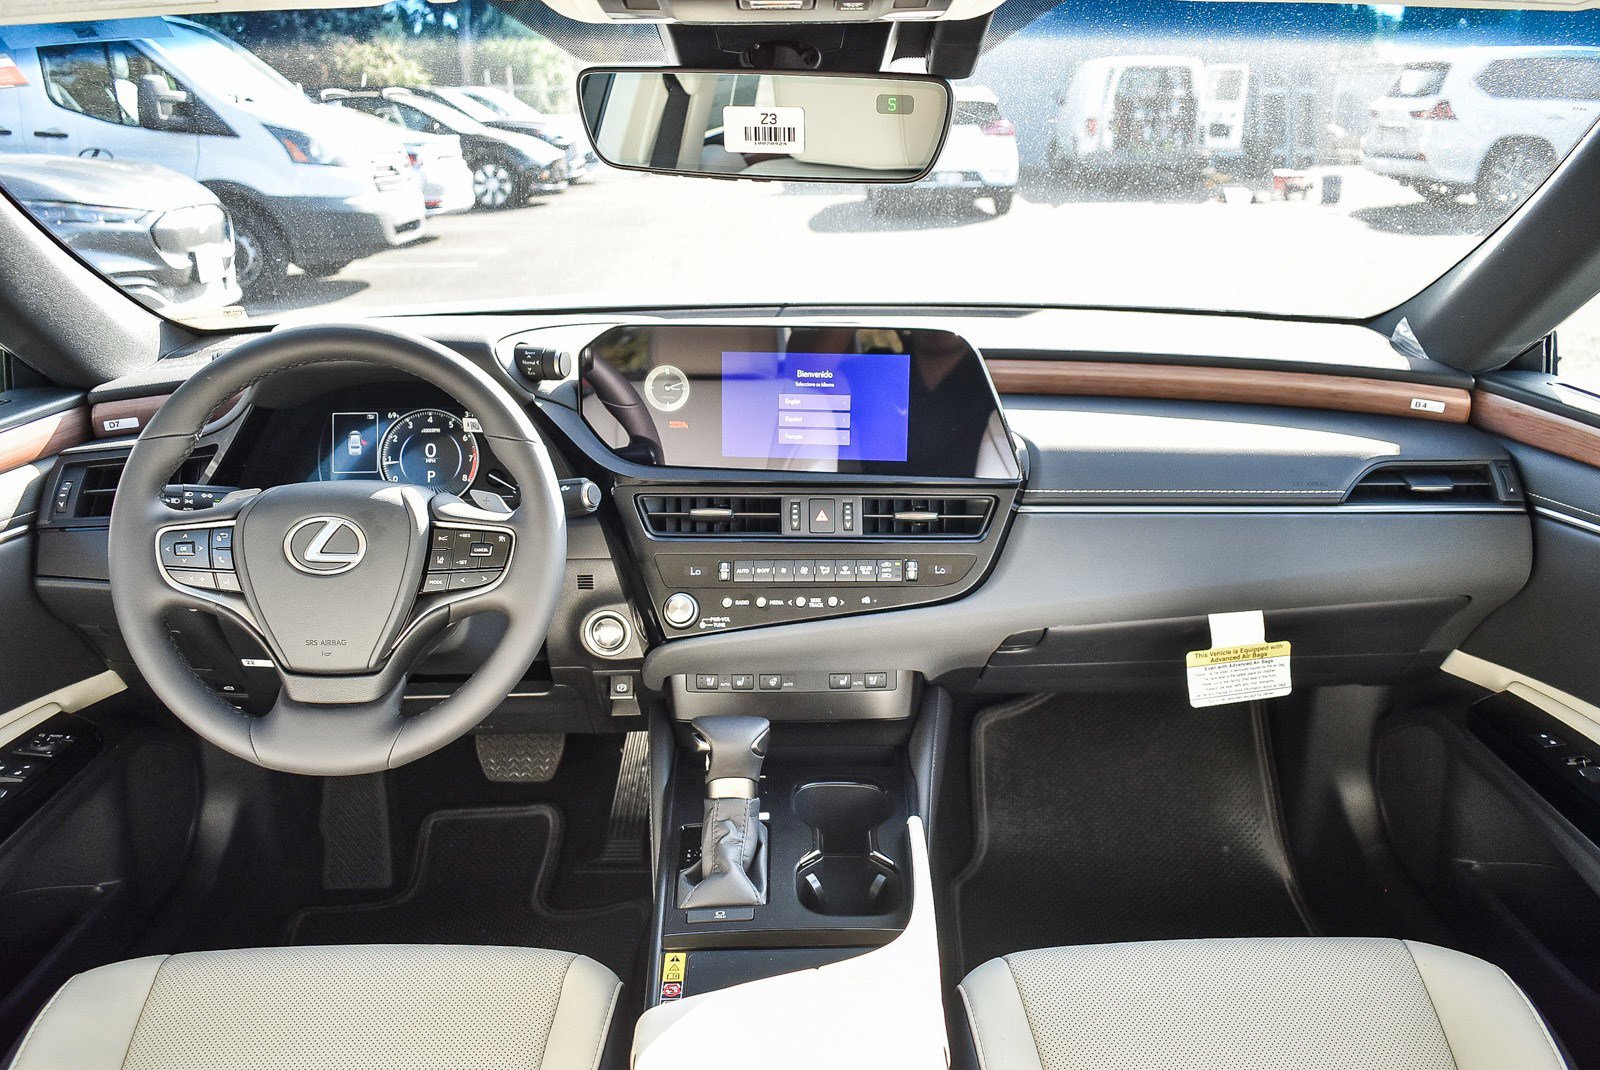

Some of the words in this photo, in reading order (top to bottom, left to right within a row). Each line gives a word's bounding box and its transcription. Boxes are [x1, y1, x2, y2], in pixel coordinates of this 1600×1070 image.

[760, 113, 778, 125] Z3
[796, 370, 834, 378] Bienvenido
[108, 420, 120, 428] D7
[408, 421, 413, 429] 3
[448, 420, 454, 428] 5
[392, 434, 398, 442] 2
[425, 443, 436, 458] 0
[427, 470, 436, 483] P
[690, 566, 702, 576] Lo
[934, 565, 946, 574] Lo
[1240, 646, 1269, 655] Equipped
